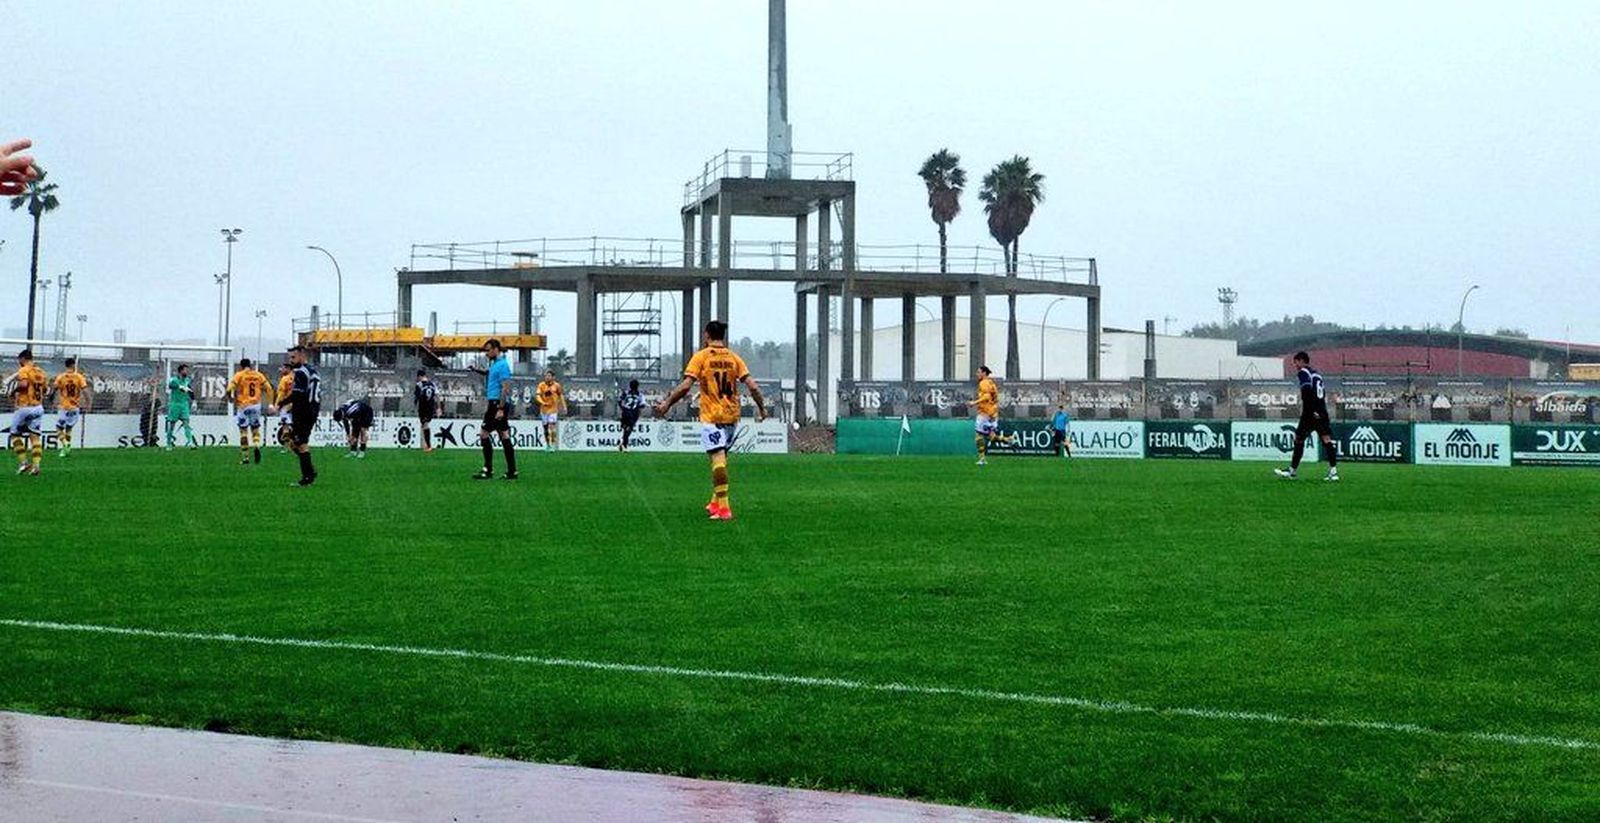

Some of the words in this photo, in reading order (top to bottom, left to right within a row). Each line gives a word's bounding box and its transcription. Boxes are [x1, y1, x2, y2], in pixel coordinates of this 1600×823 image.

[248, 382, 256, 397] 6
[714, 370, 734, 399] 14
[1535, 399, 1587, 413] albaida
[586, 424, 651, 433] DESGUCES
[1070, 431, 1133, 449] ALAHO
[1349, 441, 1402, 457] MONJE
[1424, 442, 1440, 458] EL
[1446, 443, 1500, 460] MONJE
